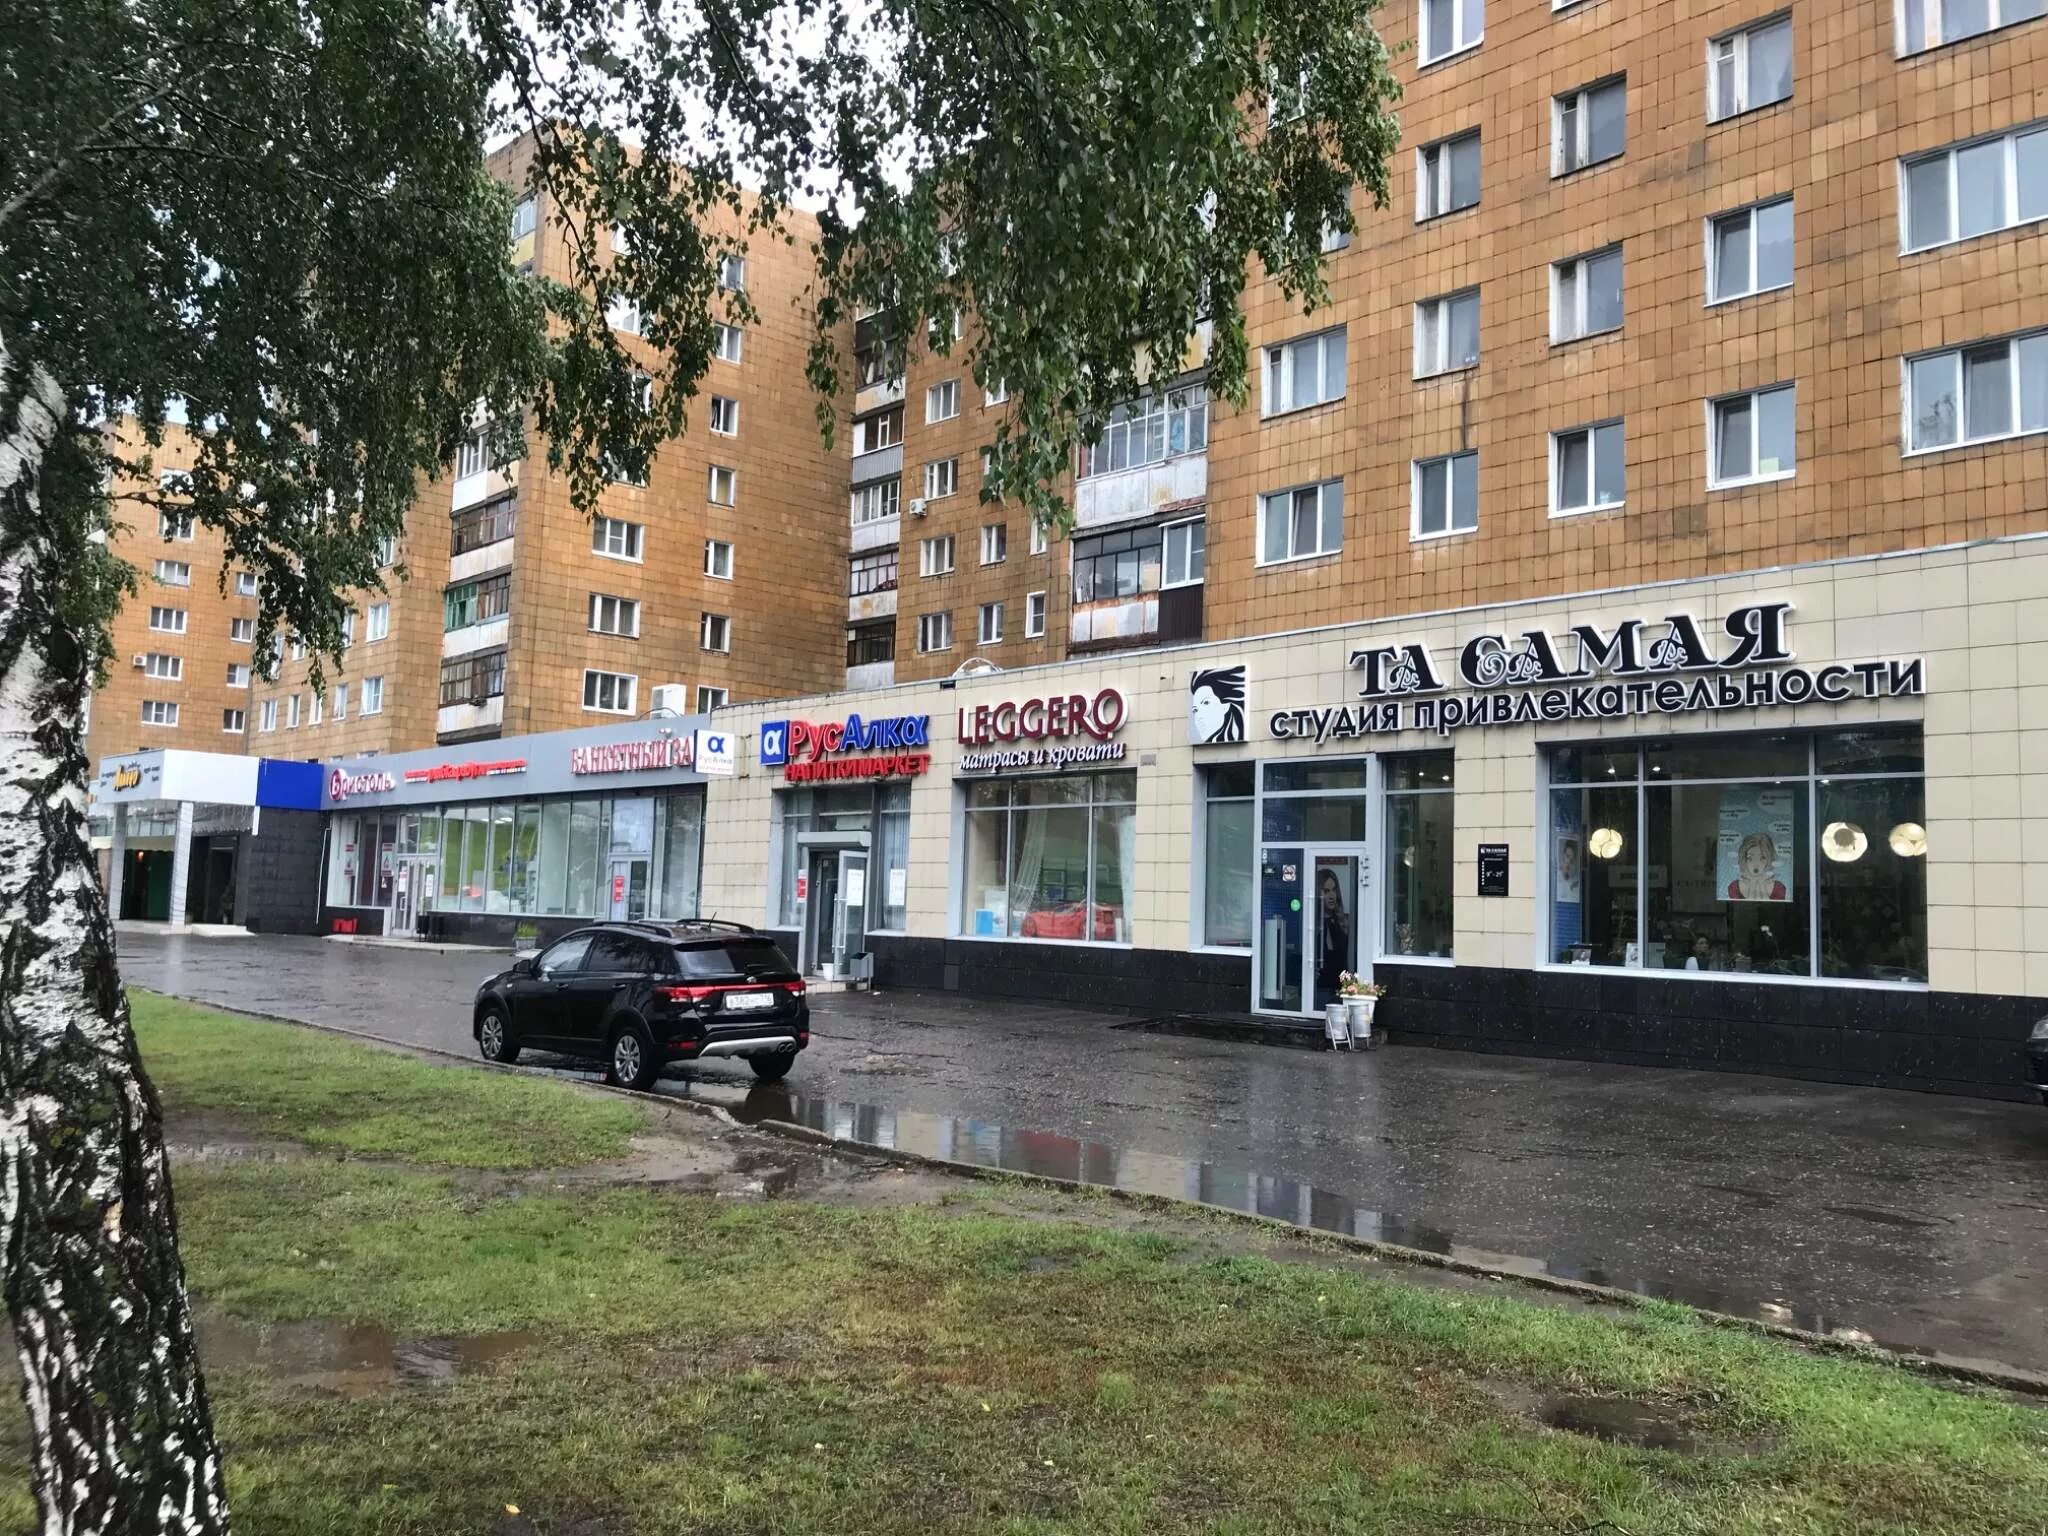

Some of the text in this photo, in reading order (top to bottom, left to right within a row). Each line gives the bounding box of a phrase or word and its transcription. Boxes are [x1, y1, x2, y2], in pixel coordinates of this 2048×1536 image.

[1348, 600, 1797, 699] ТА САМАЯ
[957, 687, 1130, 745] LEGGERO
[1269, 656, 1927, 745] студия привлекательности
[673, 735, 694, 767] ЗА
[959, 742, 1127, 775] матрасы и кровати
